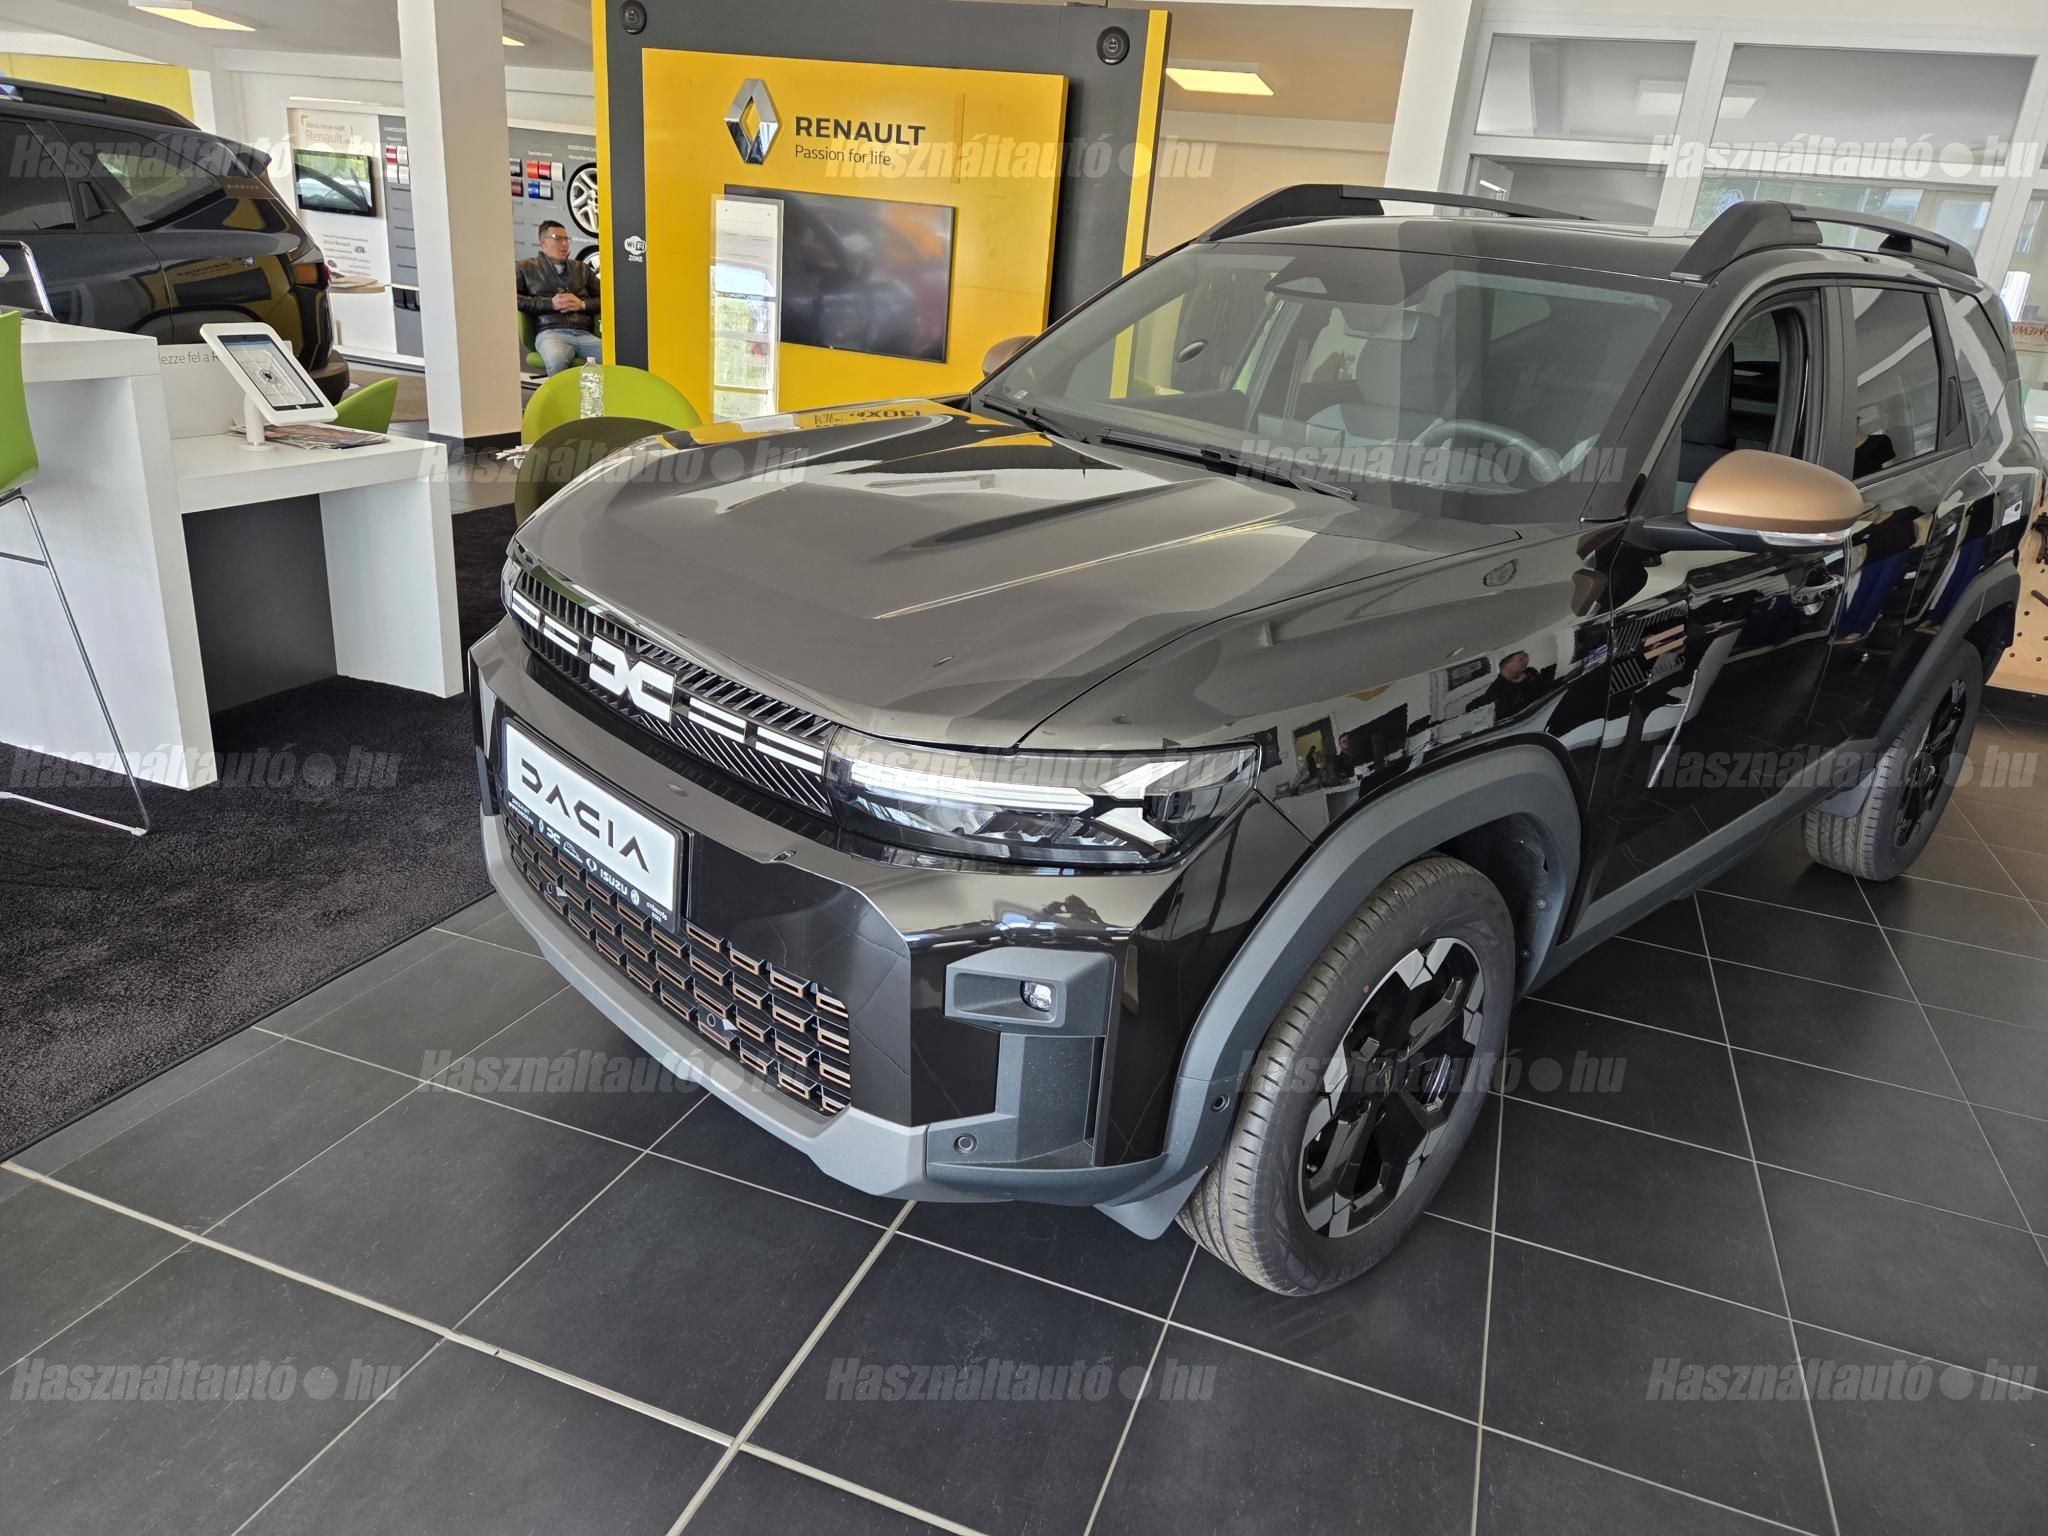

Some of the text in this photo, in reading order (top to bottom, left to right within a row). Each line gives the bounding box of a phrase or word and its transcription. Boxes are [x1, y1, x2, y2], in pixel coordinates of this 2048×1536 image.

[795, 116, 926, 146] RENAULT
[795, 144, 891, 166] Passion for life
[188, 351, 201, 363] fel
[203, 353, 210, 362] a
[521, 757, 651, 873] DACIA
[600, 868, 628, 896] ISUZU
